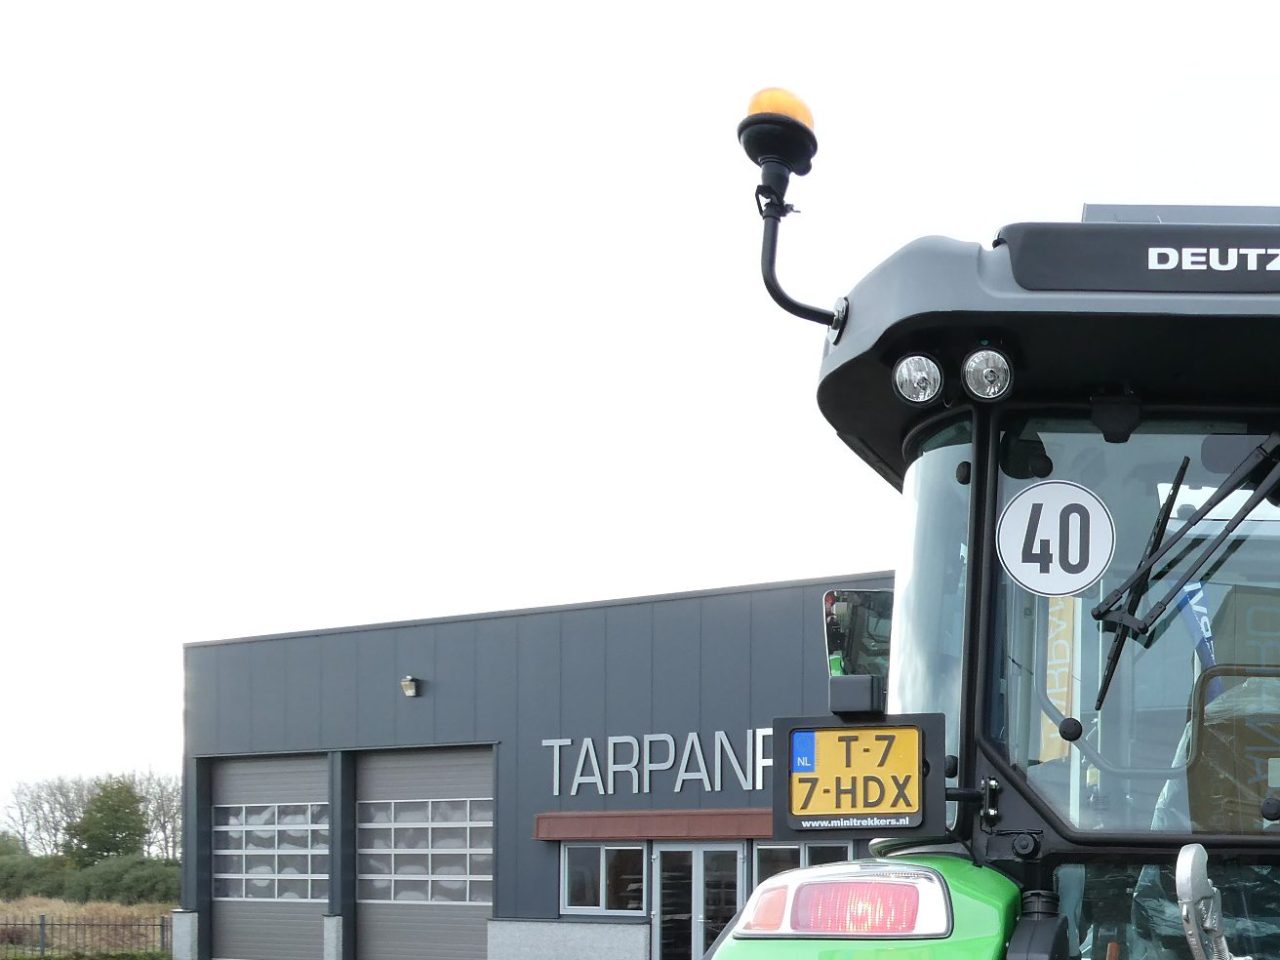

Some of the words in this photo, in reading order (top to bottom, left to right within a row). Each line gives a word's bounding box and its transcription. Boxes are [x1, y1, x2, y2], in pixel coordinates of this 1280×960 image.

[1021, 503, 1091, 575] 40
[797, 756, 812, 767] NL
[837, 734, 897, 768] T-7
[798, 774, 913, 810] 7-HDX
[801, 816, 910, 828] www.minitrekkers.nl
